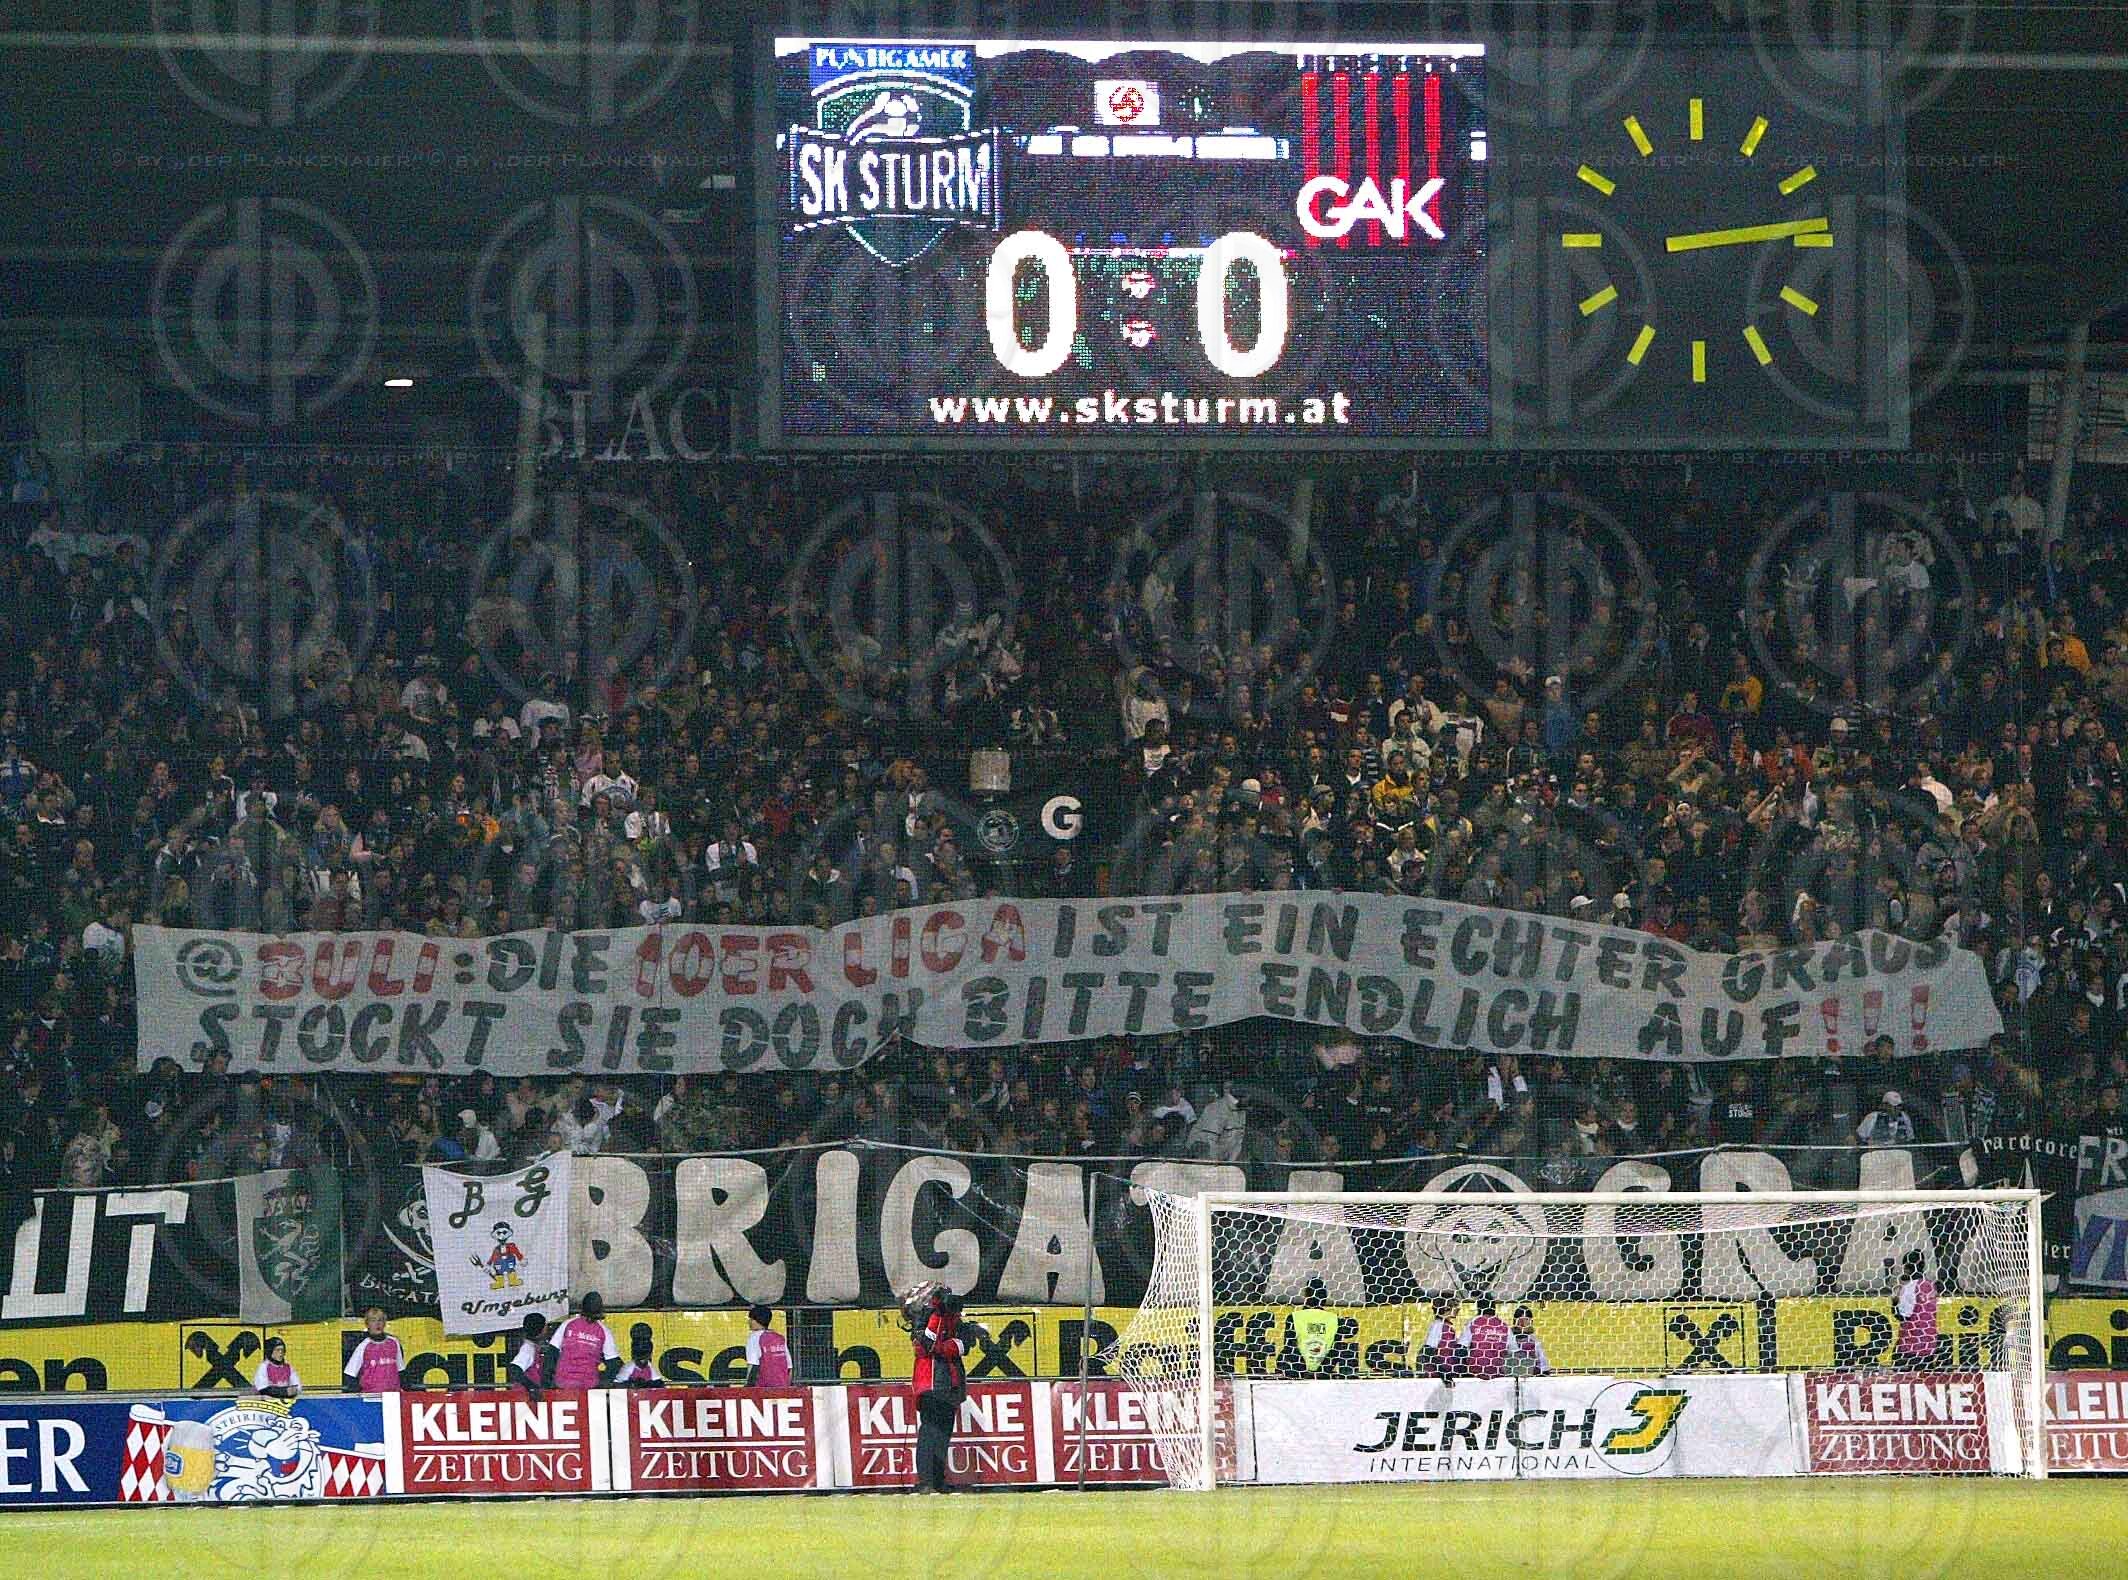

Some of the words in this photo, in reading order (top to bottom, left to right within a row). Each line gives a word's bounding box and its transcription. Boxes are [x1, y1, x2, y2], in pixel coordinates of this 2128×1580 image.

[800, 143, 849, 215] SK
[860, 143, 991, 215] STURM
[1296, 175, 1446, 239] GAK
[520, 387, 752, 462] BLAC
[928, 390, 1352, 424] www.sksturm.at
[1041, 795, 1083, 840] G
[842, 903, 1027, 987] LIGA
[1052, 902, 1184, 958] IST
[1222, 903, 1359, 962] EIN
[1400, 908, 1689, 998] ECHTER
[190, 1000, 508, 1072] STOCKT
[547, 1001, 682, 1070] SIE
[718, 987, 925, 1068] DOCH
[960, 969, 1215, 1042] BITTE
[1258, 962, 1582, 1051] ENDLICH
[639, 1399, 805, 1438] KLEINE
[858, 1394, 1025, 1435] KLNE
[1816, 1383, 1979, 1421] KLEINE
[2045, 1382, 2128, 1420] LEI
[411, 1401, 580, 1441] KLEINE
[1353, 1408, 1597, 1454] JERICH
[640, 1448, 809, 1479] ZEITUNG
[861, 1445, 1028, 1475] ZEIUNG
[1370, 1455, 1598, 1474] INTERNATIONAL
[1820, 1433, 1981, 1462] ZEITUNG
[2046, 1432, 2128, 1460] EITU
[413, 1453, 584, 1484] ZEITUNG
